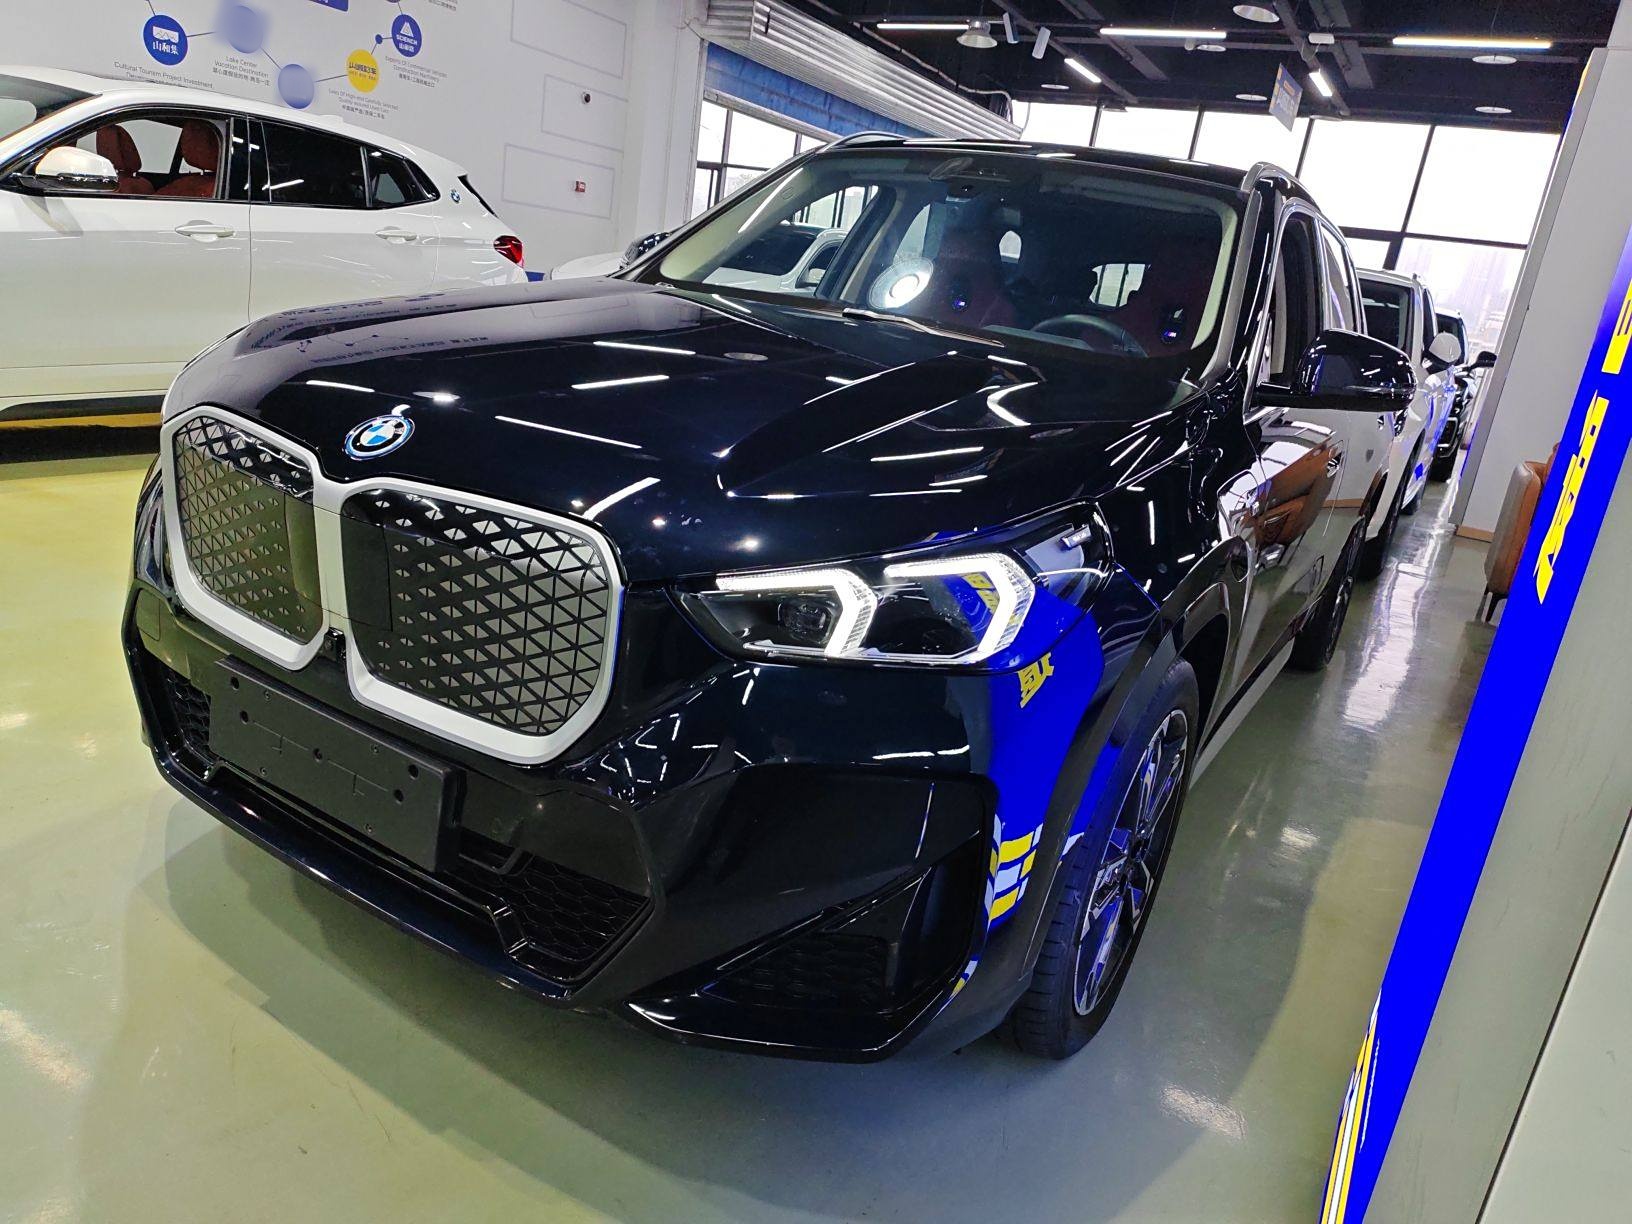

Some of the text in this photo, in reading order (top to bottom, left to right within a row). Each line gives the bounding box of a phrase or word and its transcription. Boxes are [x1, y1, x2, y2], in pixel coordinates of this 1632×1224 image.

[153, 41, 179, 55] 山和集
[114, 61, 138, 71] Cultural
[139, 66, 162, 76] Tourism
[163, 73, 182, 82] Project
[184, 78, 213, 89] Investment
